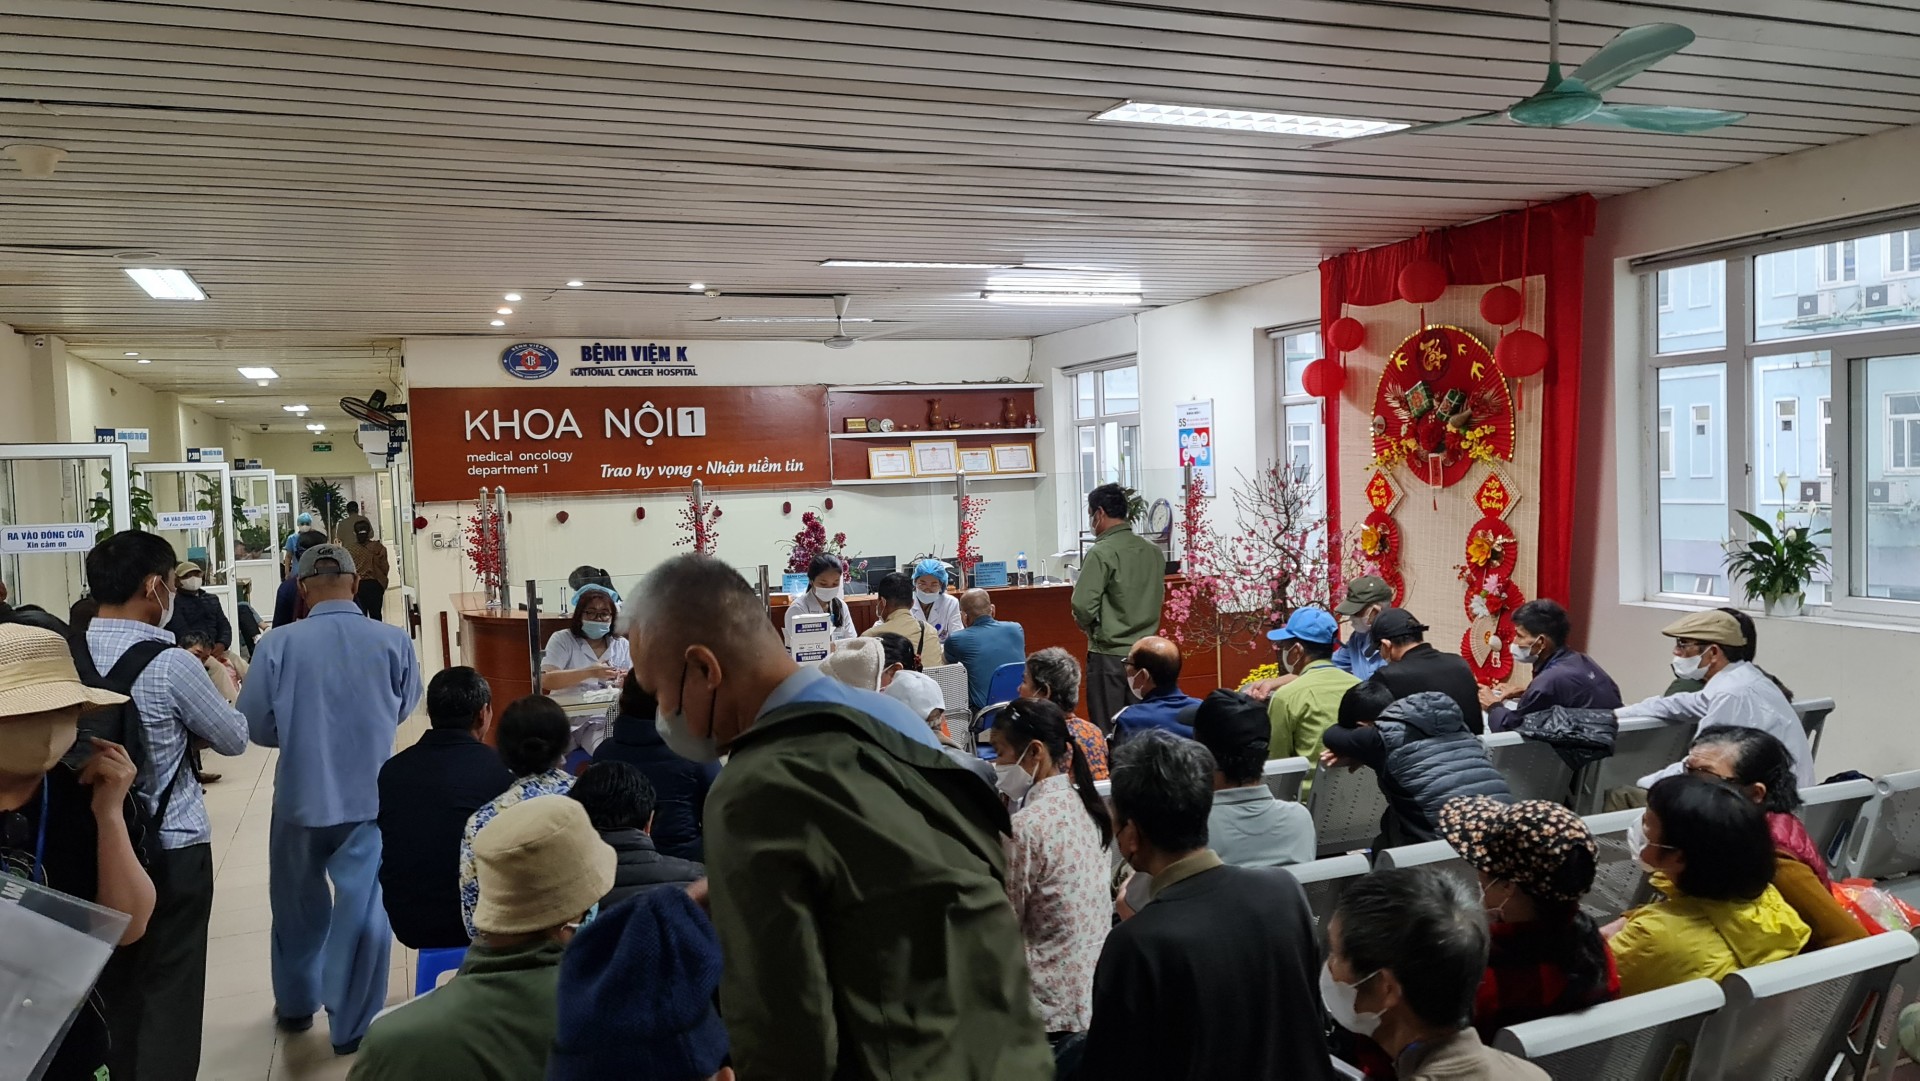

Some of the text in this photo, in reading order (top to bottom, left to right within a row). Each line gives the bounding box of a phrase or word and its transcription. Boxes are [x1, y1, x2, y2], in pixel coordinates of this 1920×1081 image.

[580, 342, 688, 365] BỆNH VIỆN K
[618, 368, 654, 377] CANCER
[656, 368, 698, 377] HOSPITAL
[464, 401, 696, 446] KHOA NỘI 1
[466, 449, 573, 463] medical oncology
[467, 463, 549, 479] department 1
[600, 463, 693, 480] Trao hy vọng
[706, 456, 805, 477] Nhận niềm tin
[7, 528, 85, 541] RA VÀO ĐÓNG CỬA
[26, 541, 39, 549] Xin
[40, 540, 56, 548] cảm
